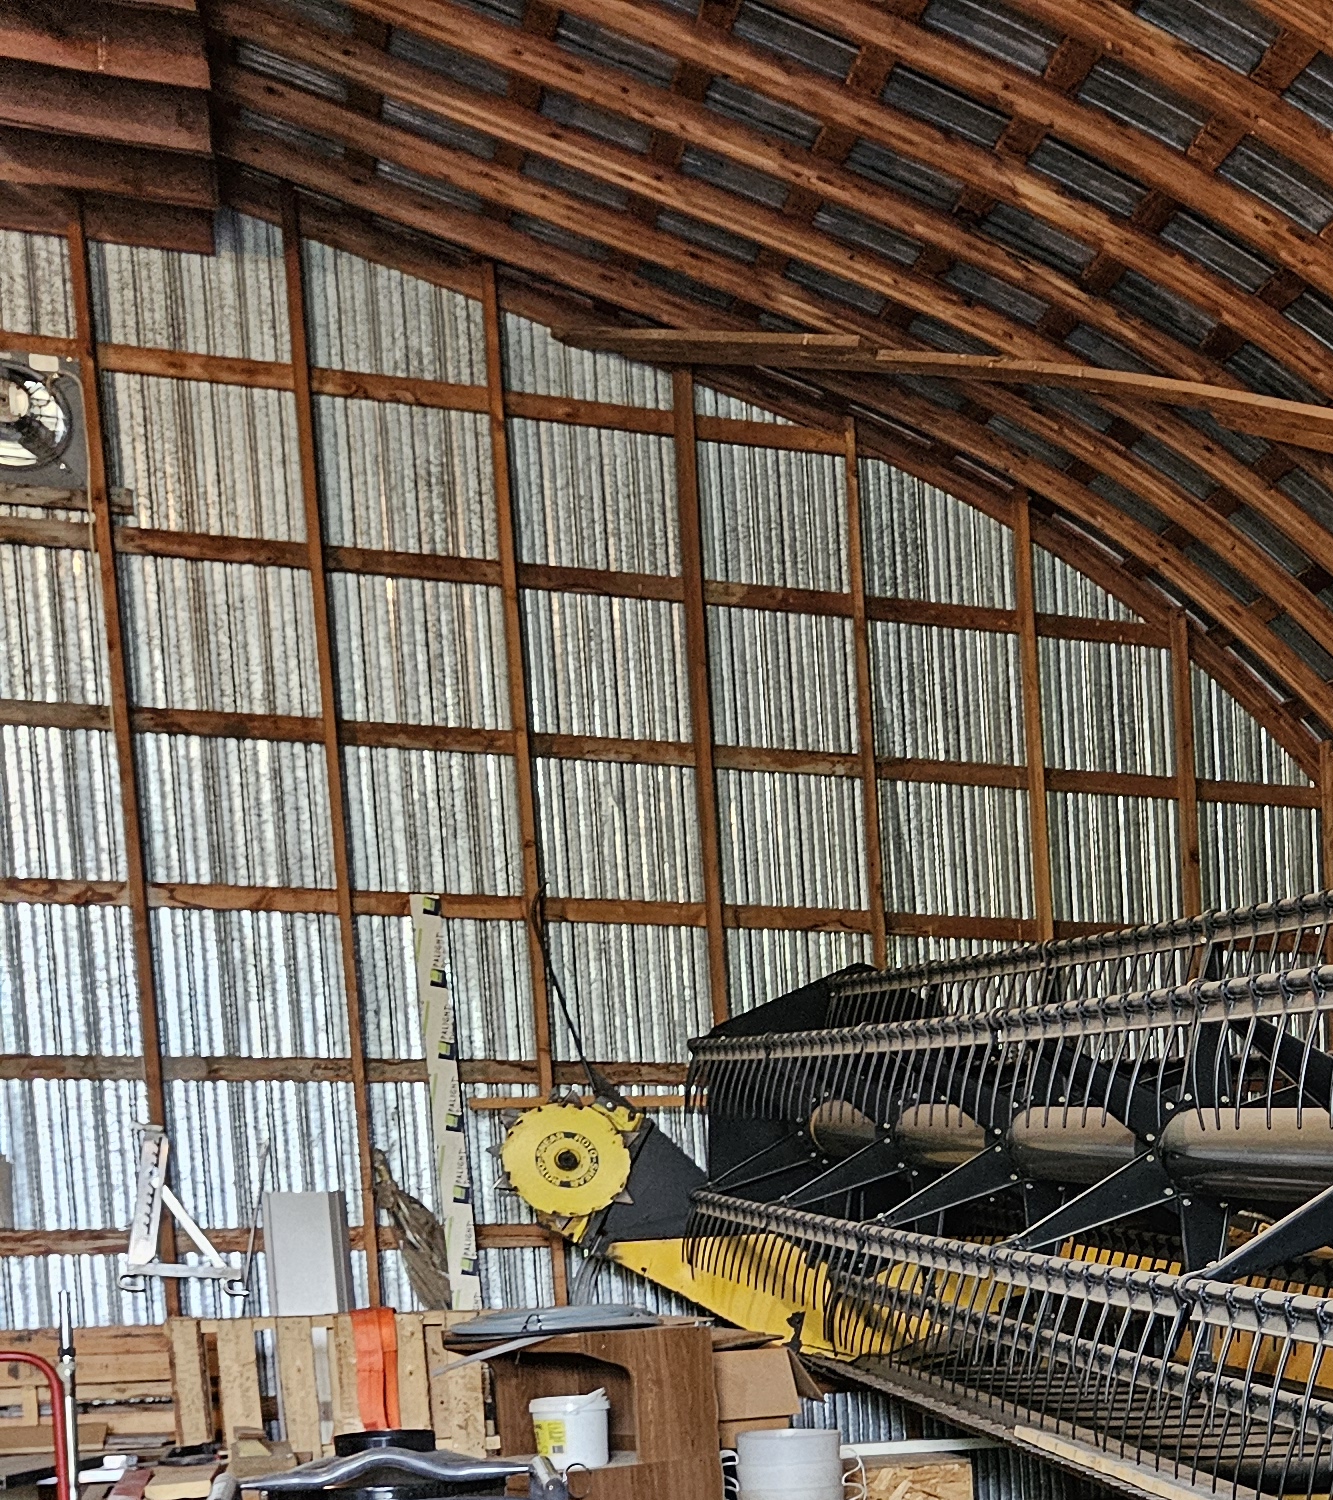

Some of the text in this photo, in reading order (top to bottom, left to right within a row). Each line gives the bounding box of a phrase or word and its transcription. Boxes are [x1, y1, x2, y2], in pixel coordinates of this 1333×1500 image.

[440, 1004, 453, 1040] PALIGHT
[448, 1077, 458, 1112] PALIGHT
[456, 1149, 467, 1185] PALIGHT
[463, 1222, 475, 1256] PALIGHT
